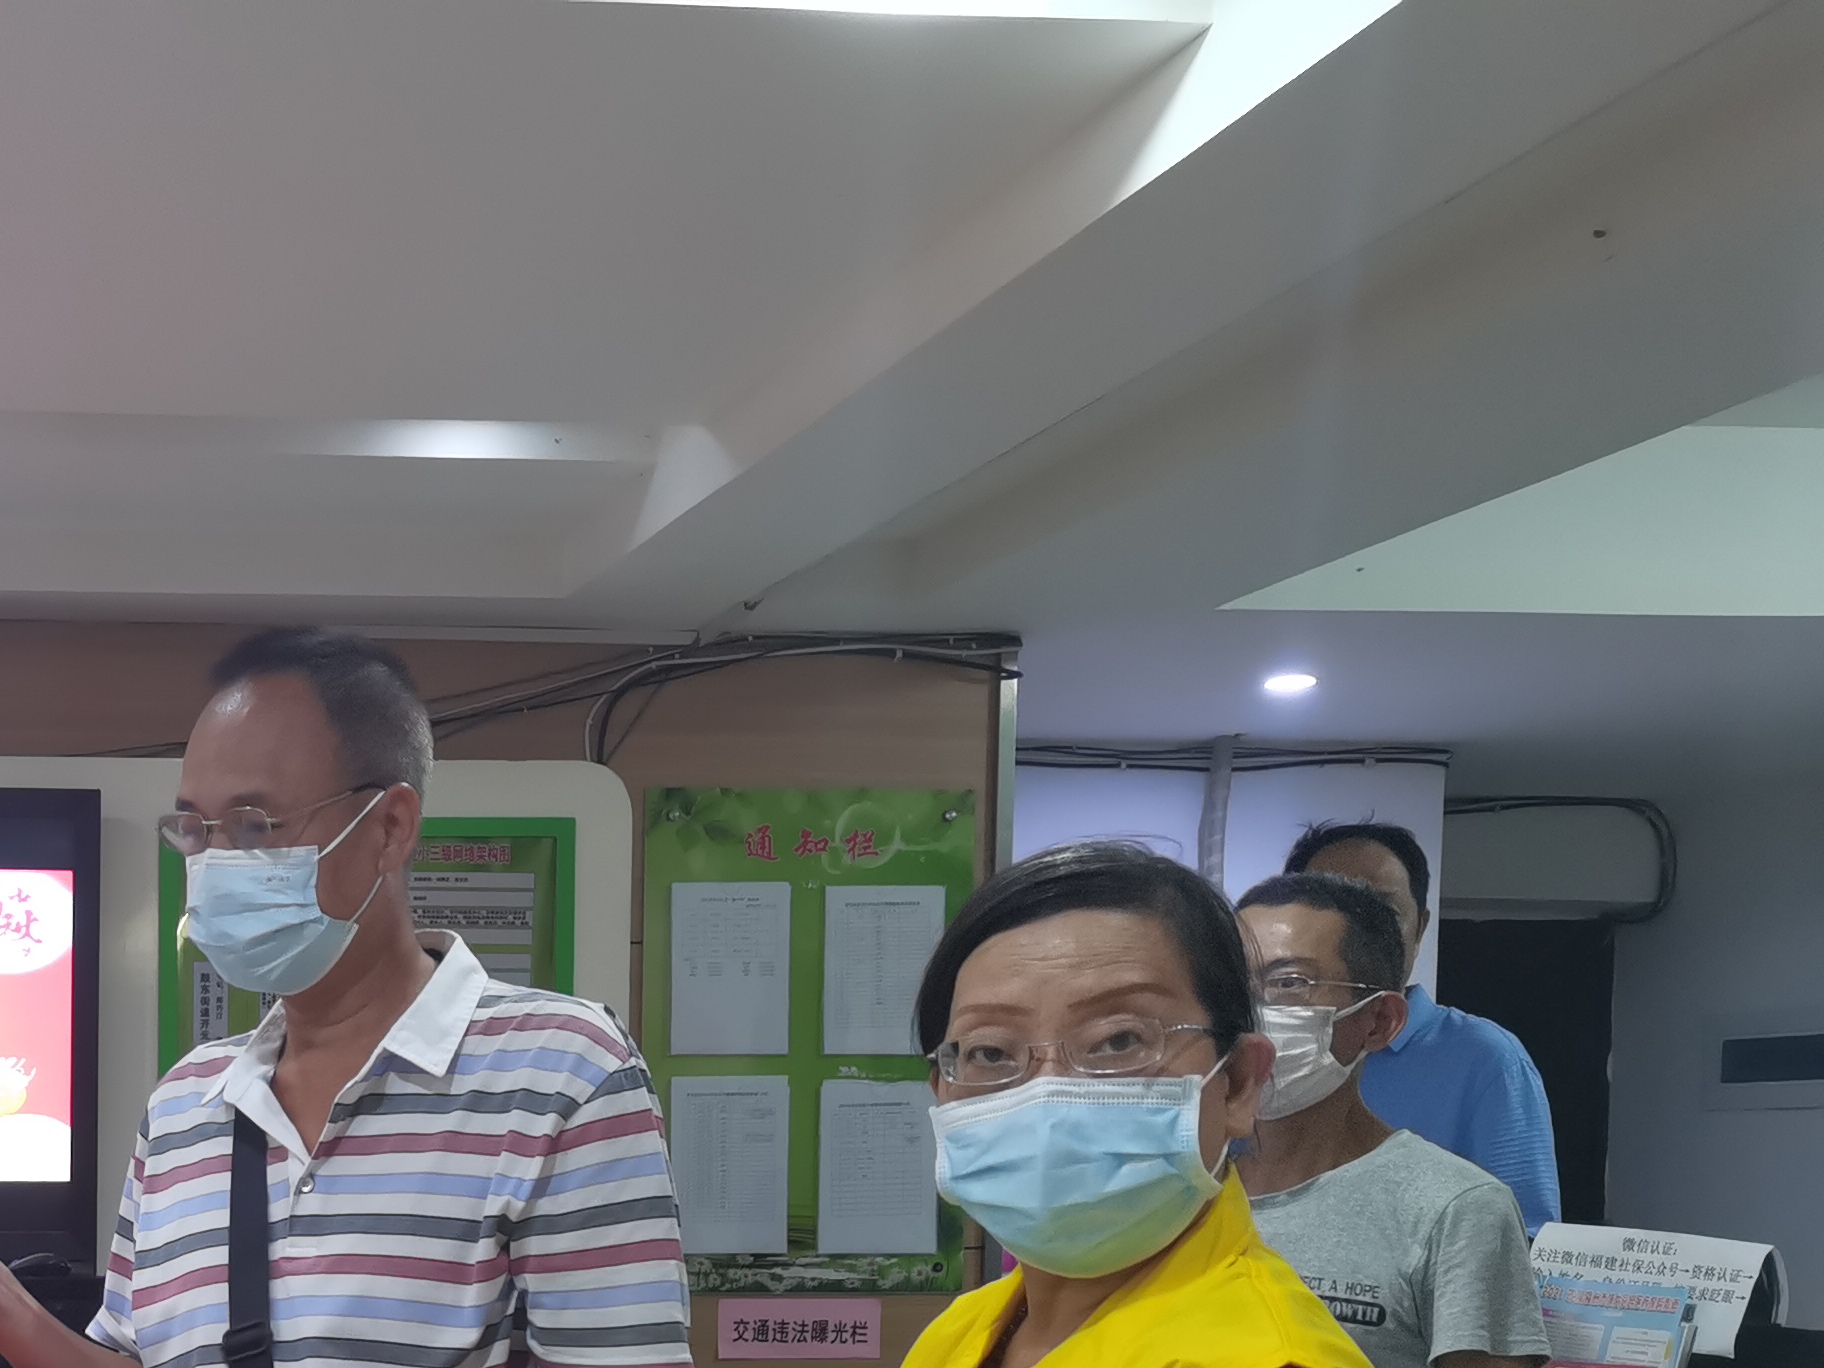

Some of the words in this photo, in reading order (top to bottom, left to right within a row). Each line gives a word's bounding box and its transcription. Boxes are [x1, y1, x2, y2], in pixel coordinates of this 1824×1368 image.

[744, 824, 880, 862] 通知栏
[1532, 1246, 1679, 1278] 关注微信福建社保公众号
[1690, 1264, 1744, 1283] 资格认证
[1328, 1279, 1338, 1293] A
[1344, 1281, 1381, 1299] HOPE
[732, 1318, 869, 1345] 交通违法曝光栏
